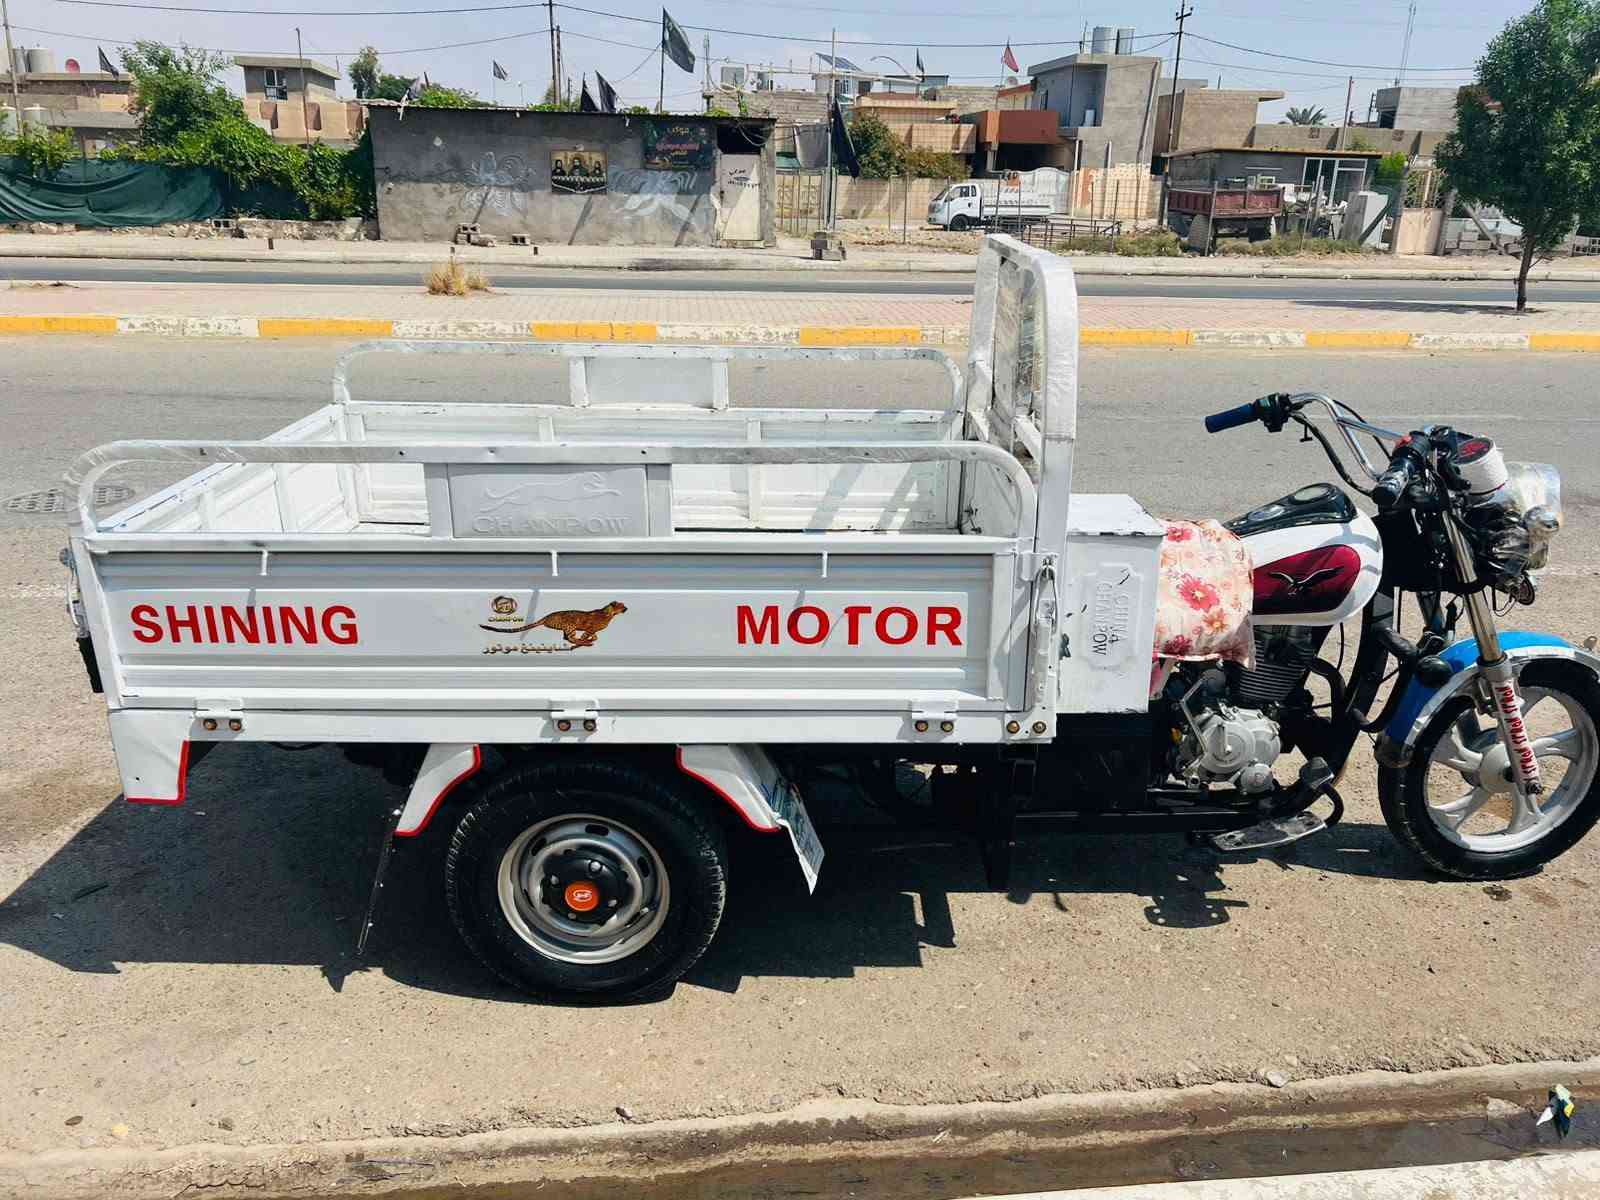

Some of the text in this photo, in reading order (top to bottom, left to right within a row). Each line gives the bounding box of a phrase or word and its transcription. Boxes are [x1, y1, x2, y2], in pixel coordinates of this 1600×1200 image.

[471, 515, 630, 535] CHANPOW
[131, 604, 359, 644] SHINING
[737, 604, 962, 646] MOTOR
[482, 642, 518, 654] موتور
